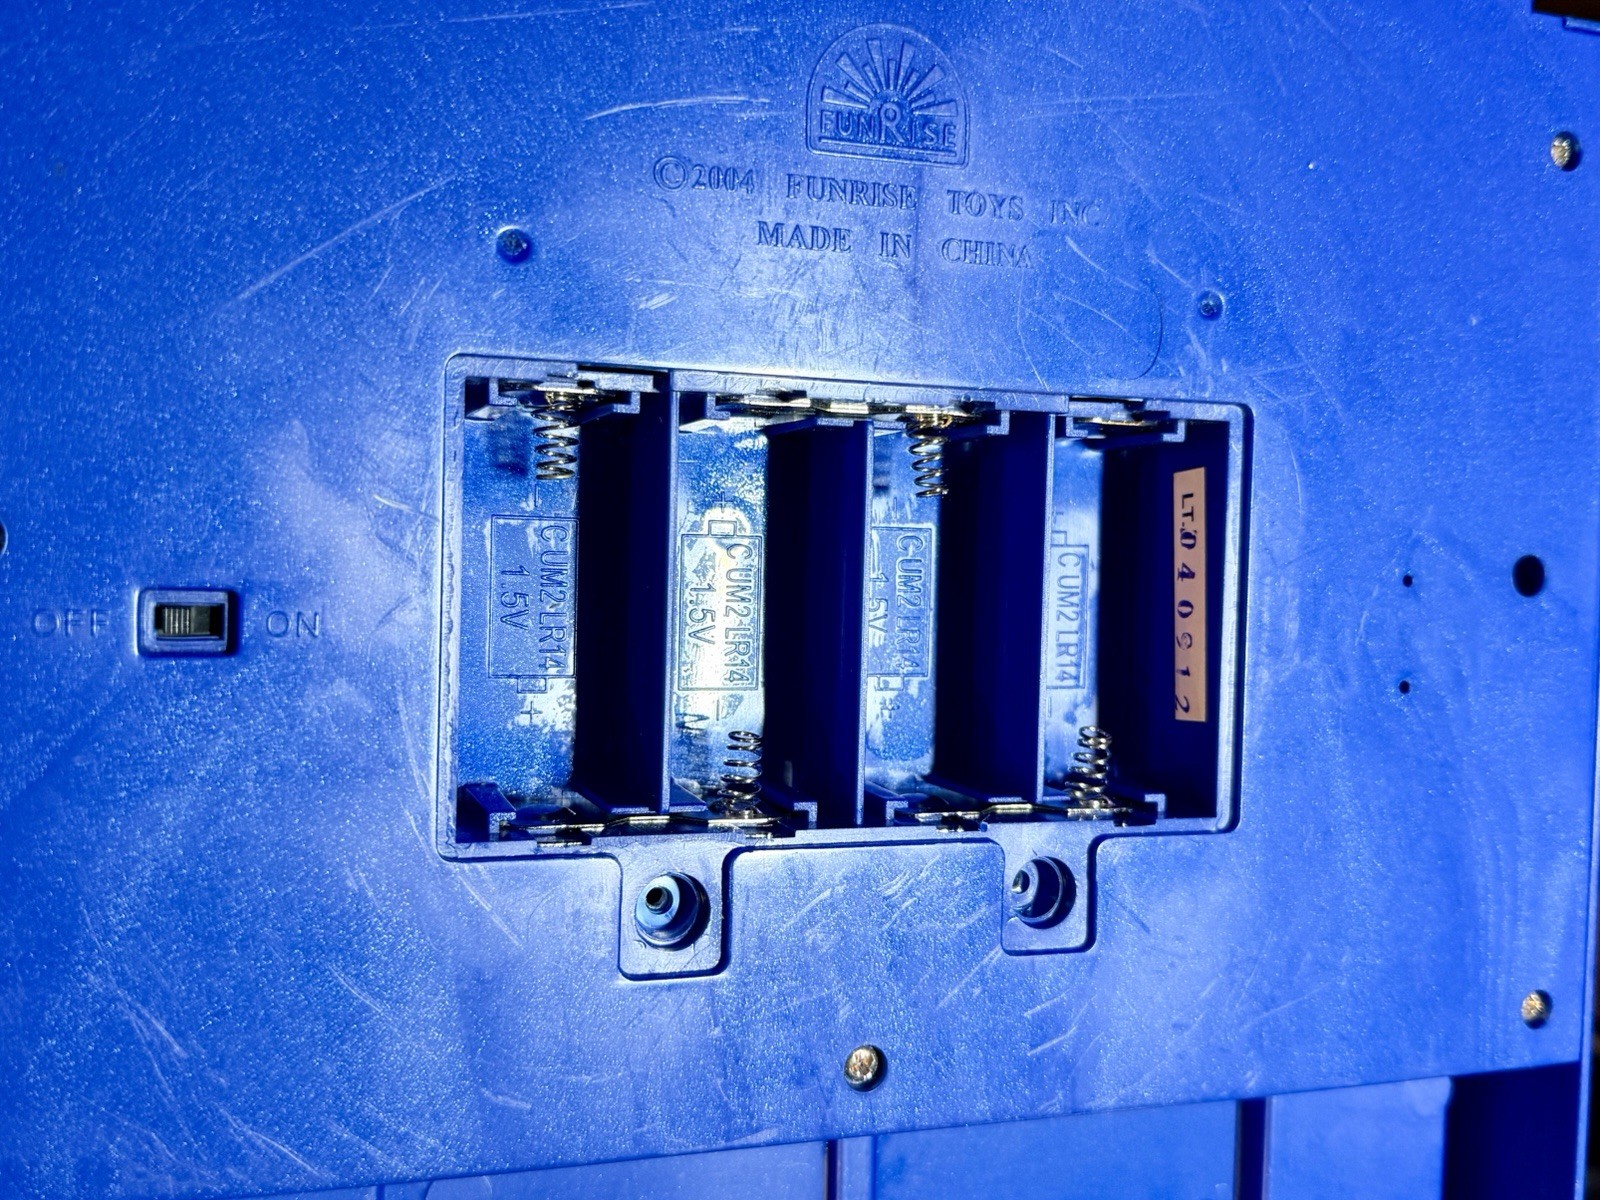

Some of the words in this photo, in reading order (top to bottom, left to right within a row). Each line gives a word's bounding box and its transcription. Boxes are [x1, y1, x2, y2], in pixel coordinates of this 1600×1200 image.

[818, 102, 958, 149] FUNRISE
[786, 172, 917, 211] FUNRISE
[946, 188, 1024, 222] TOYS
[756, 220, 852, 253] MADE
[879, 232, 912, 259] IN
[940, 236, 1034, 270] CHINA
[31, 608, 108, 637] OFF
[500, 565, 529, 631] 1.5V
[688, 582, 717, 647] 1.5V
[265, 610, 320, 637] ON
